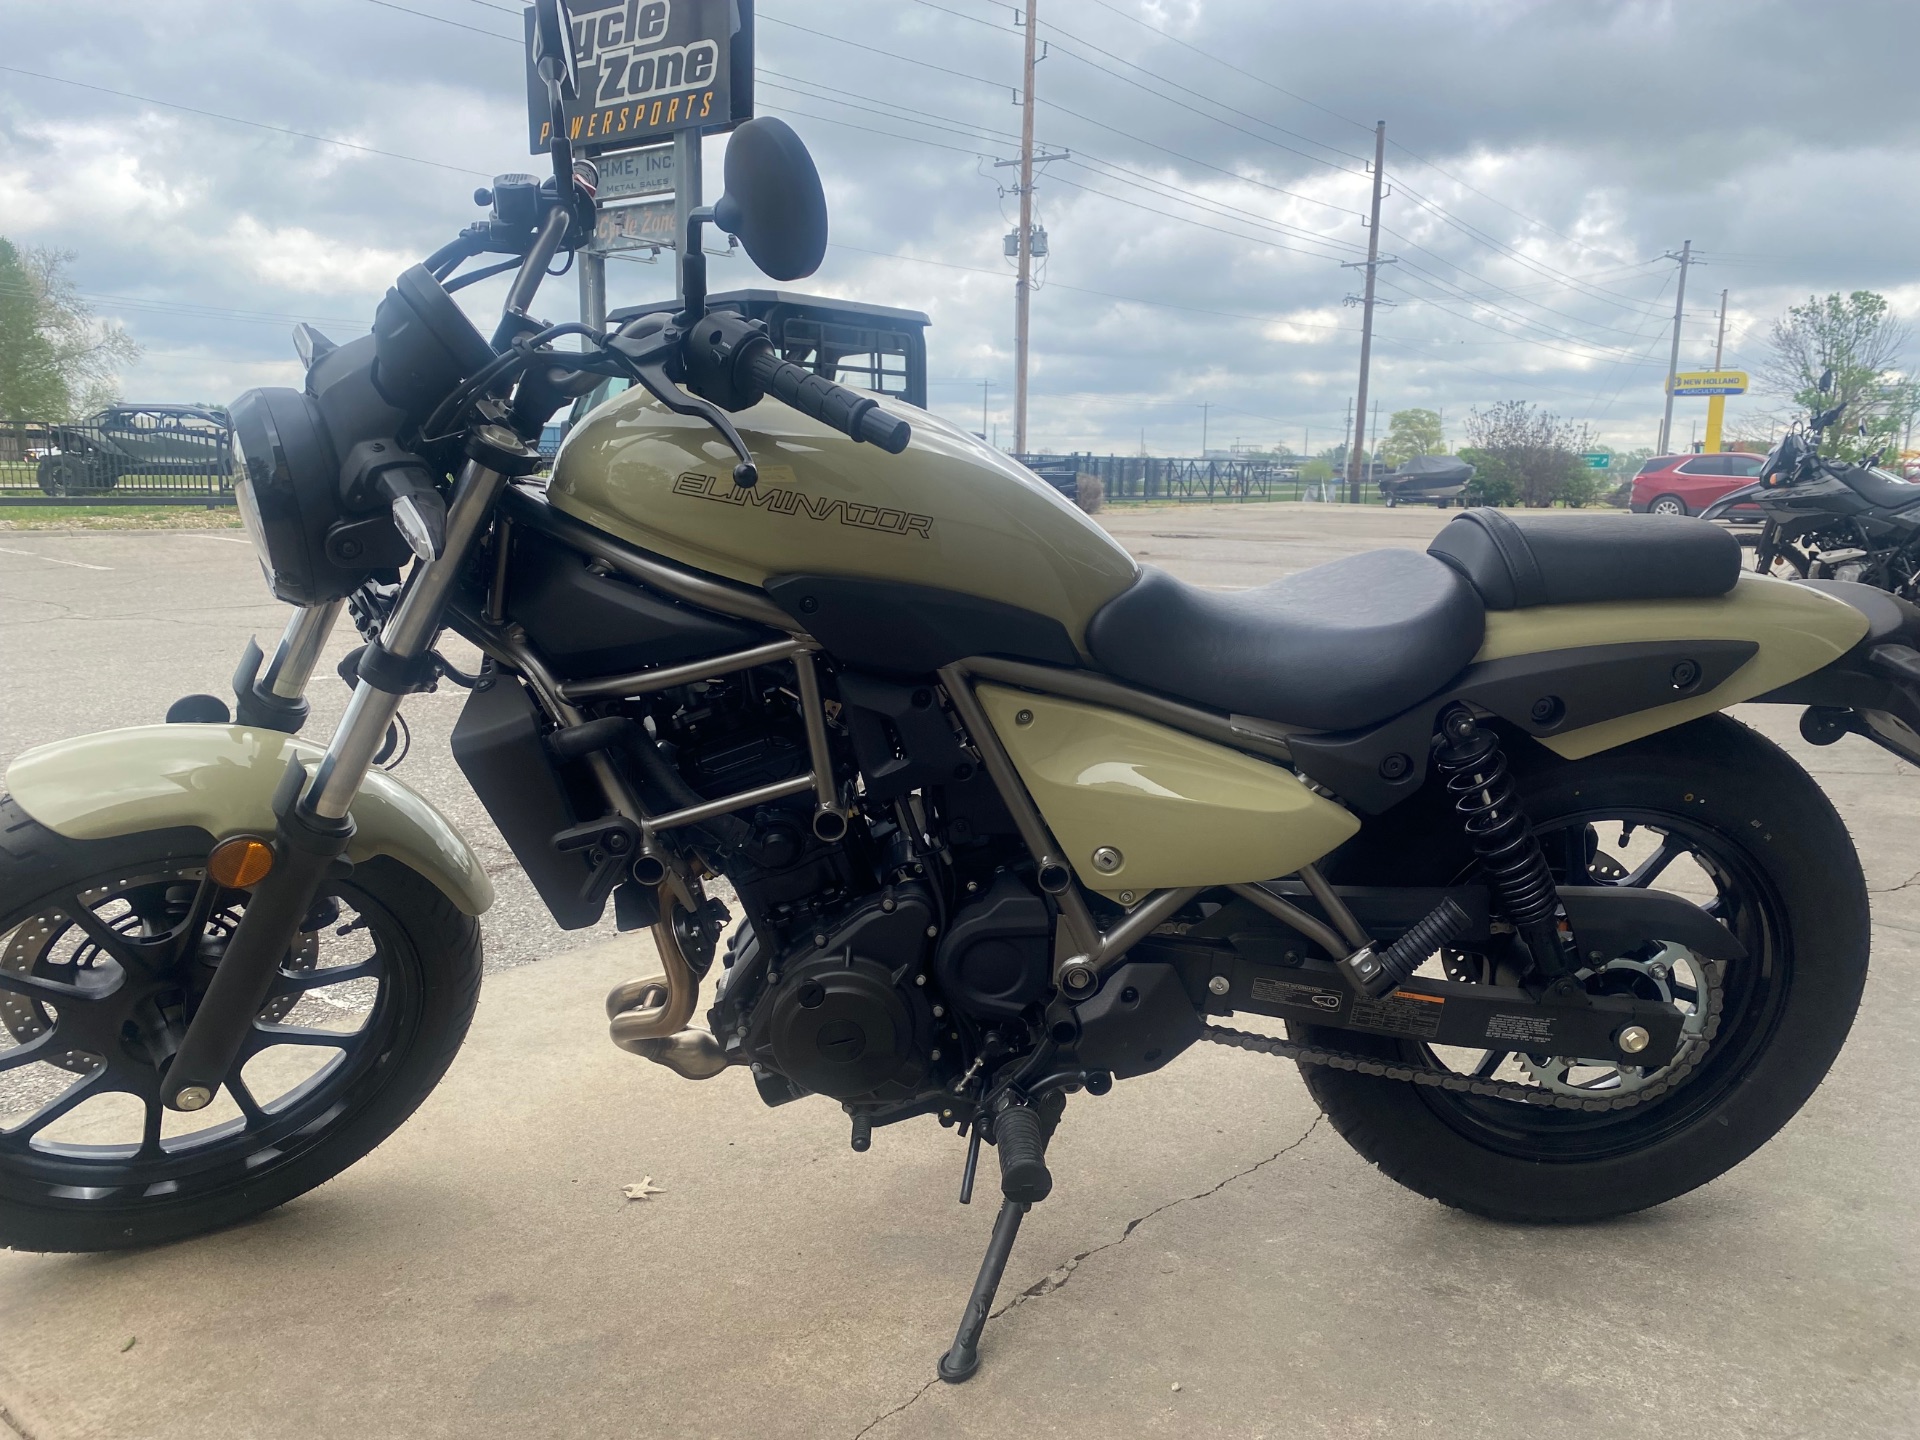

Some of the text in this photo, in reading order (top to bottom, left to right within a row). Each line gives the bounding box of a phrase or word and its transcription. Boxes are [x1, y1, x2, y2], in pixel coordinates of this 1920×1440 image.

[535, 0, 670, 68] ycle
[596, 40, 717, 107] Zone
[540, 92, 713, 145] PWERSPORTS
[606, 178, 669, 192] METAL SALES
[597, 215, 637, 244] Cyle
[1683, 377, 1740, 386] NEW HOLLAND
[673, 471, 933, 539] ELIMINATOR
